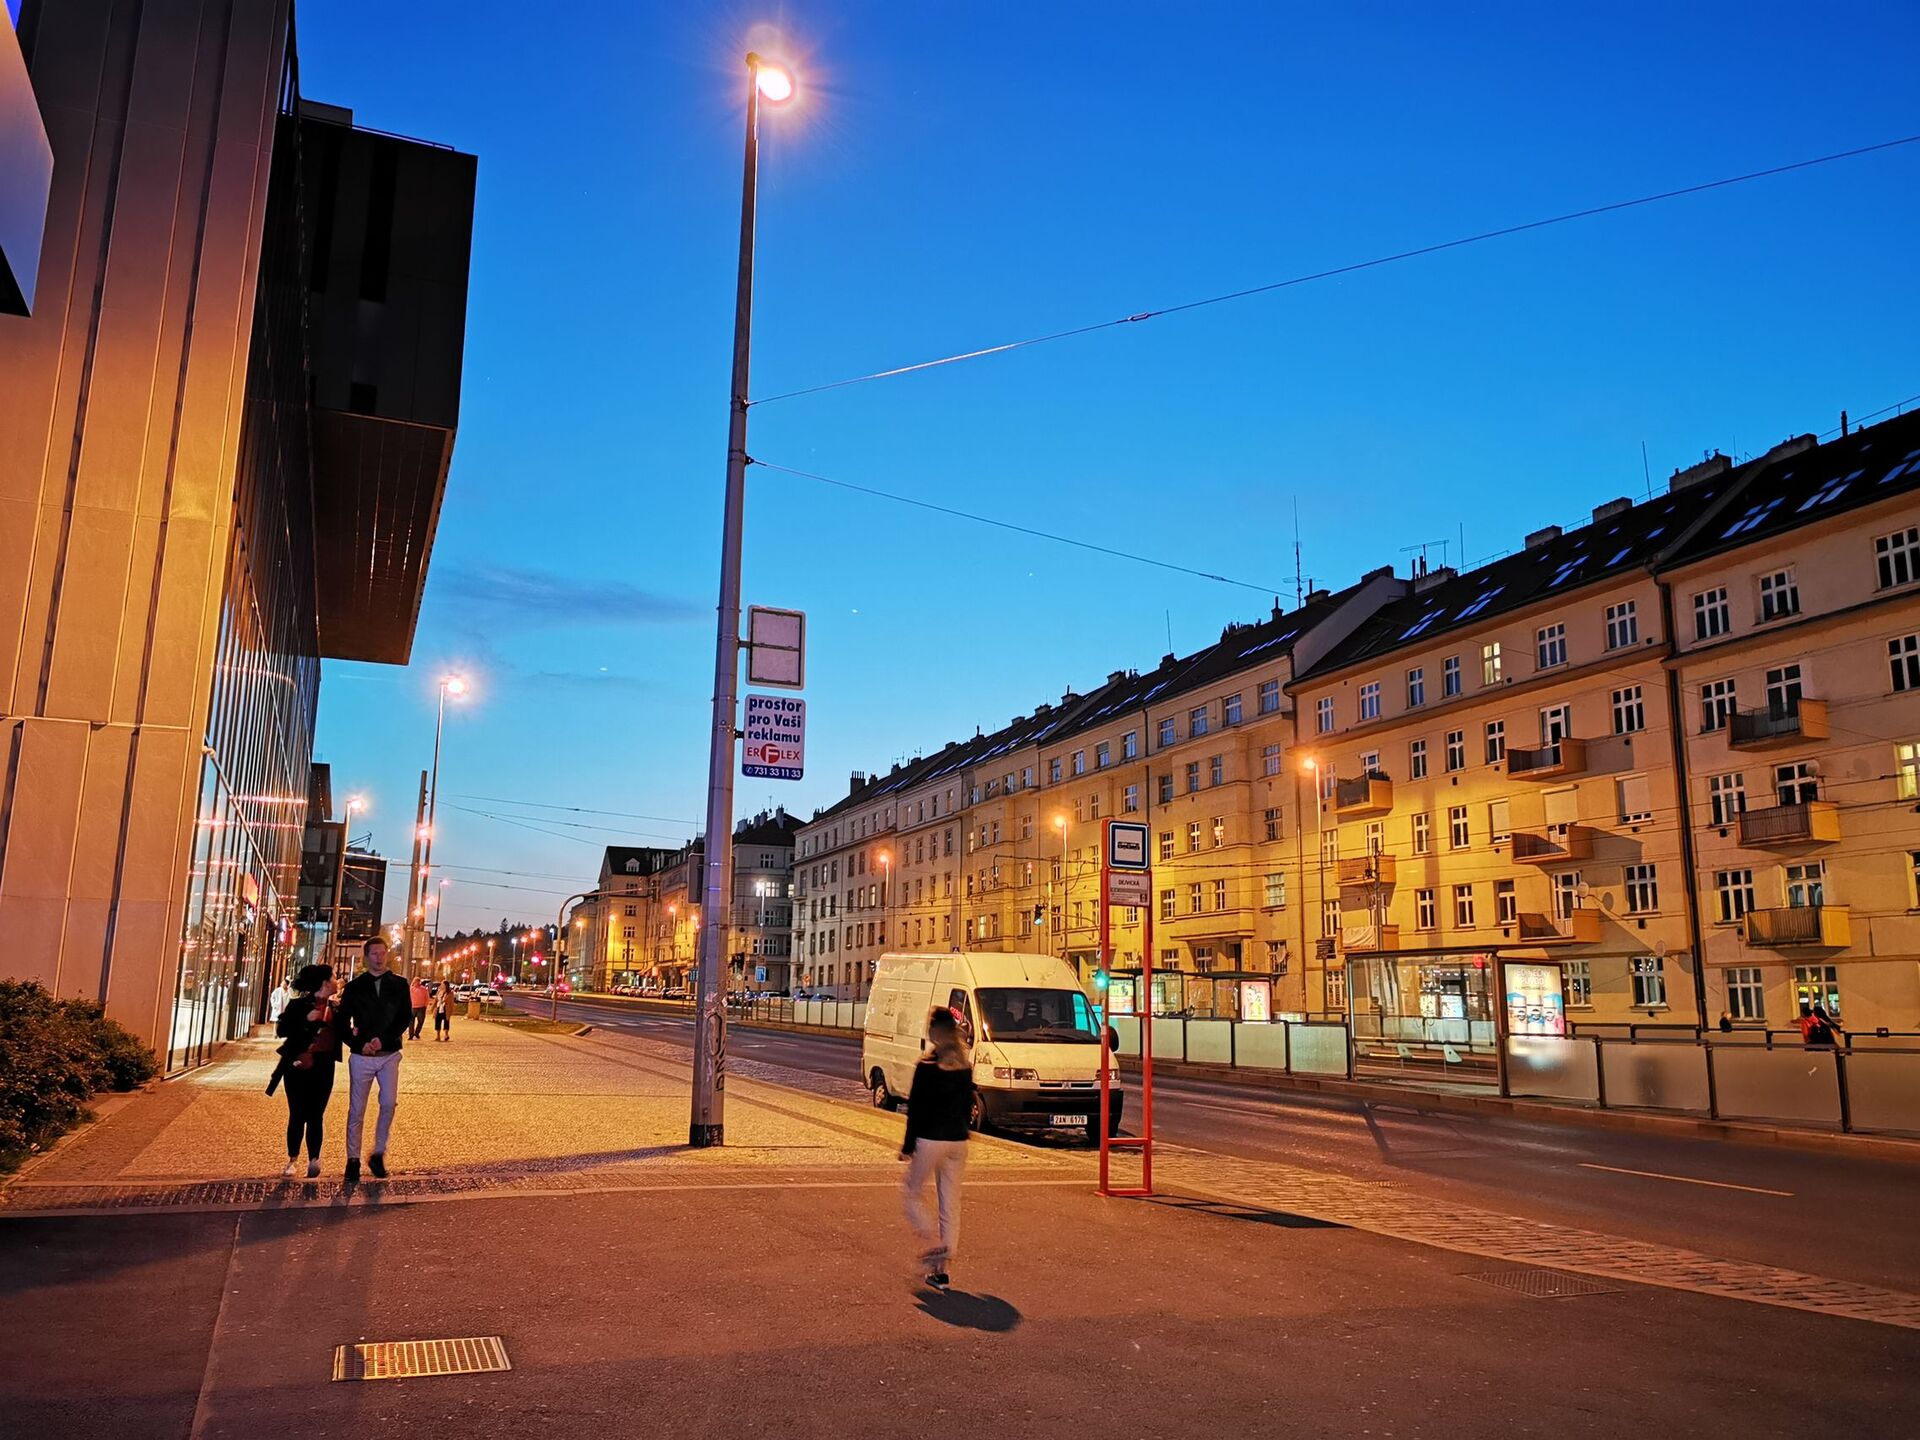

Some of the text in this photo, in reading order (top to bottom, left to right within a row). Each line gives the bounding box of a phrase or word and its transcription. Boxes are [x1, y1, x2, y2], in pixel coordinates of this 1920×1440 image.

[748, 698, 802, 712] prostor
[748, 714, 802, 728] pro Vaši
[747, 727, 801, 743] reklamu
[754, 766, 801, 778] 731 33 11 33
